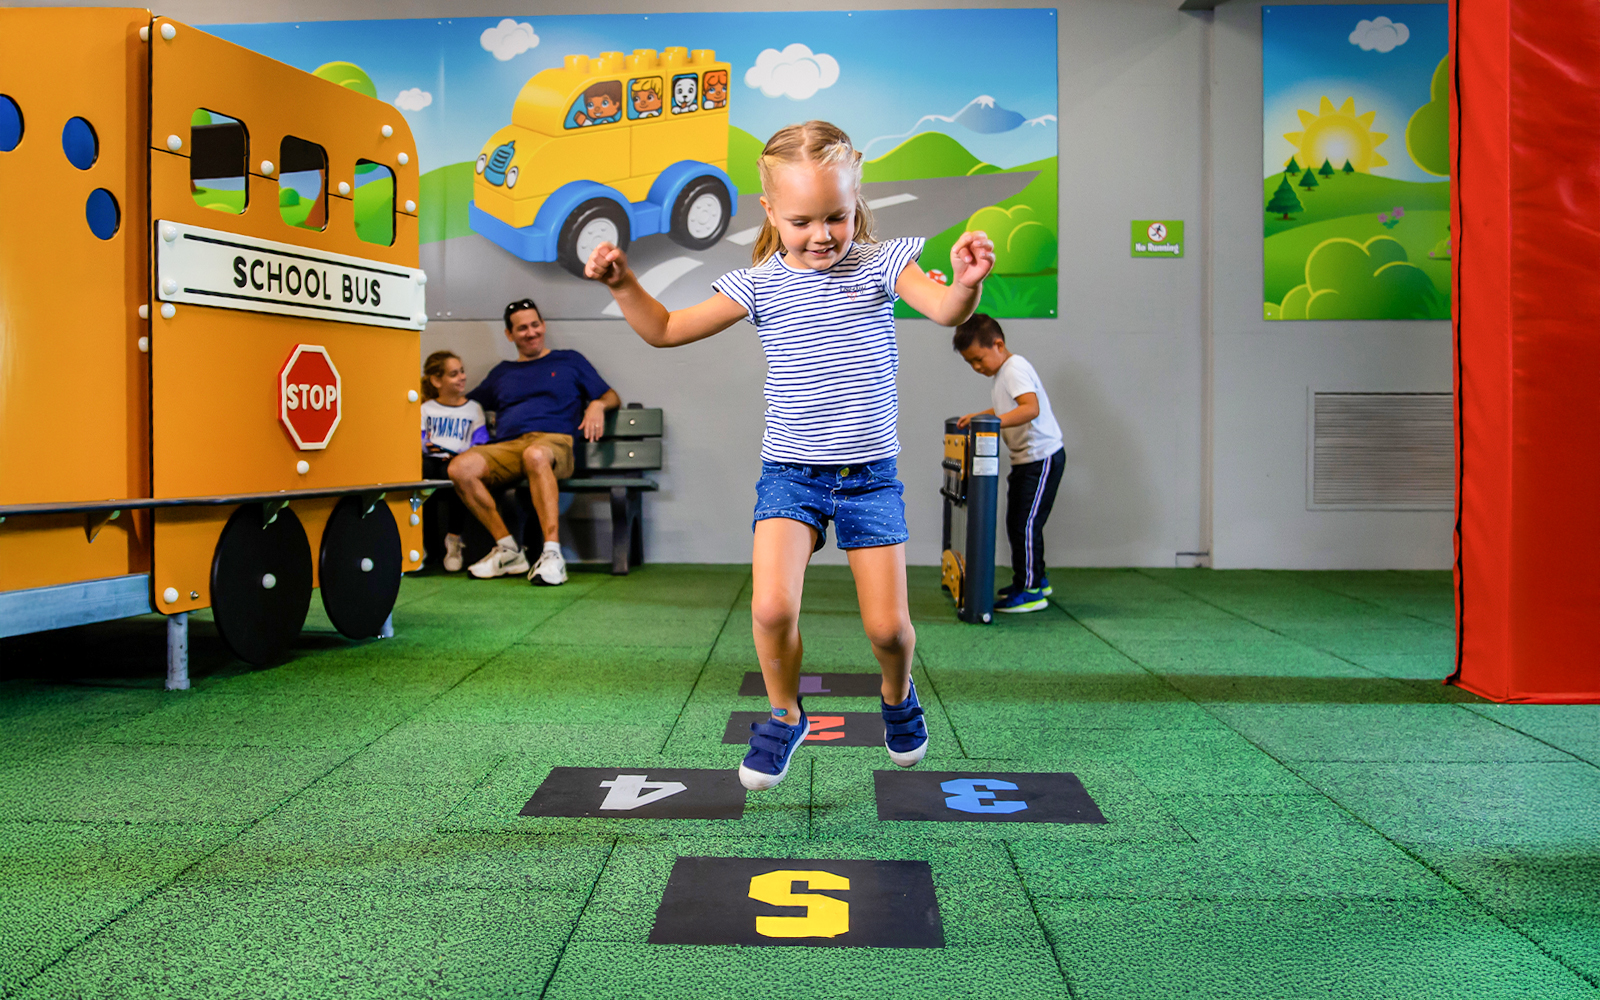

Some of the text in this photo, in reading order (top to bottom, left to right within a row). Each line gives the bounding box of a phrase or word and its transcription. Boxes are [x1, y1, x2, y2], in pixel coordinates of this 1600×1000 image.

[1135, 242, 1146, 252] No
[233, 256, 381, 307] SCHOOL BUS
[287, 384, 337, 410] STOP
[600, 774, 687, 811] 4
[940, 778, 1028, 814] 3
